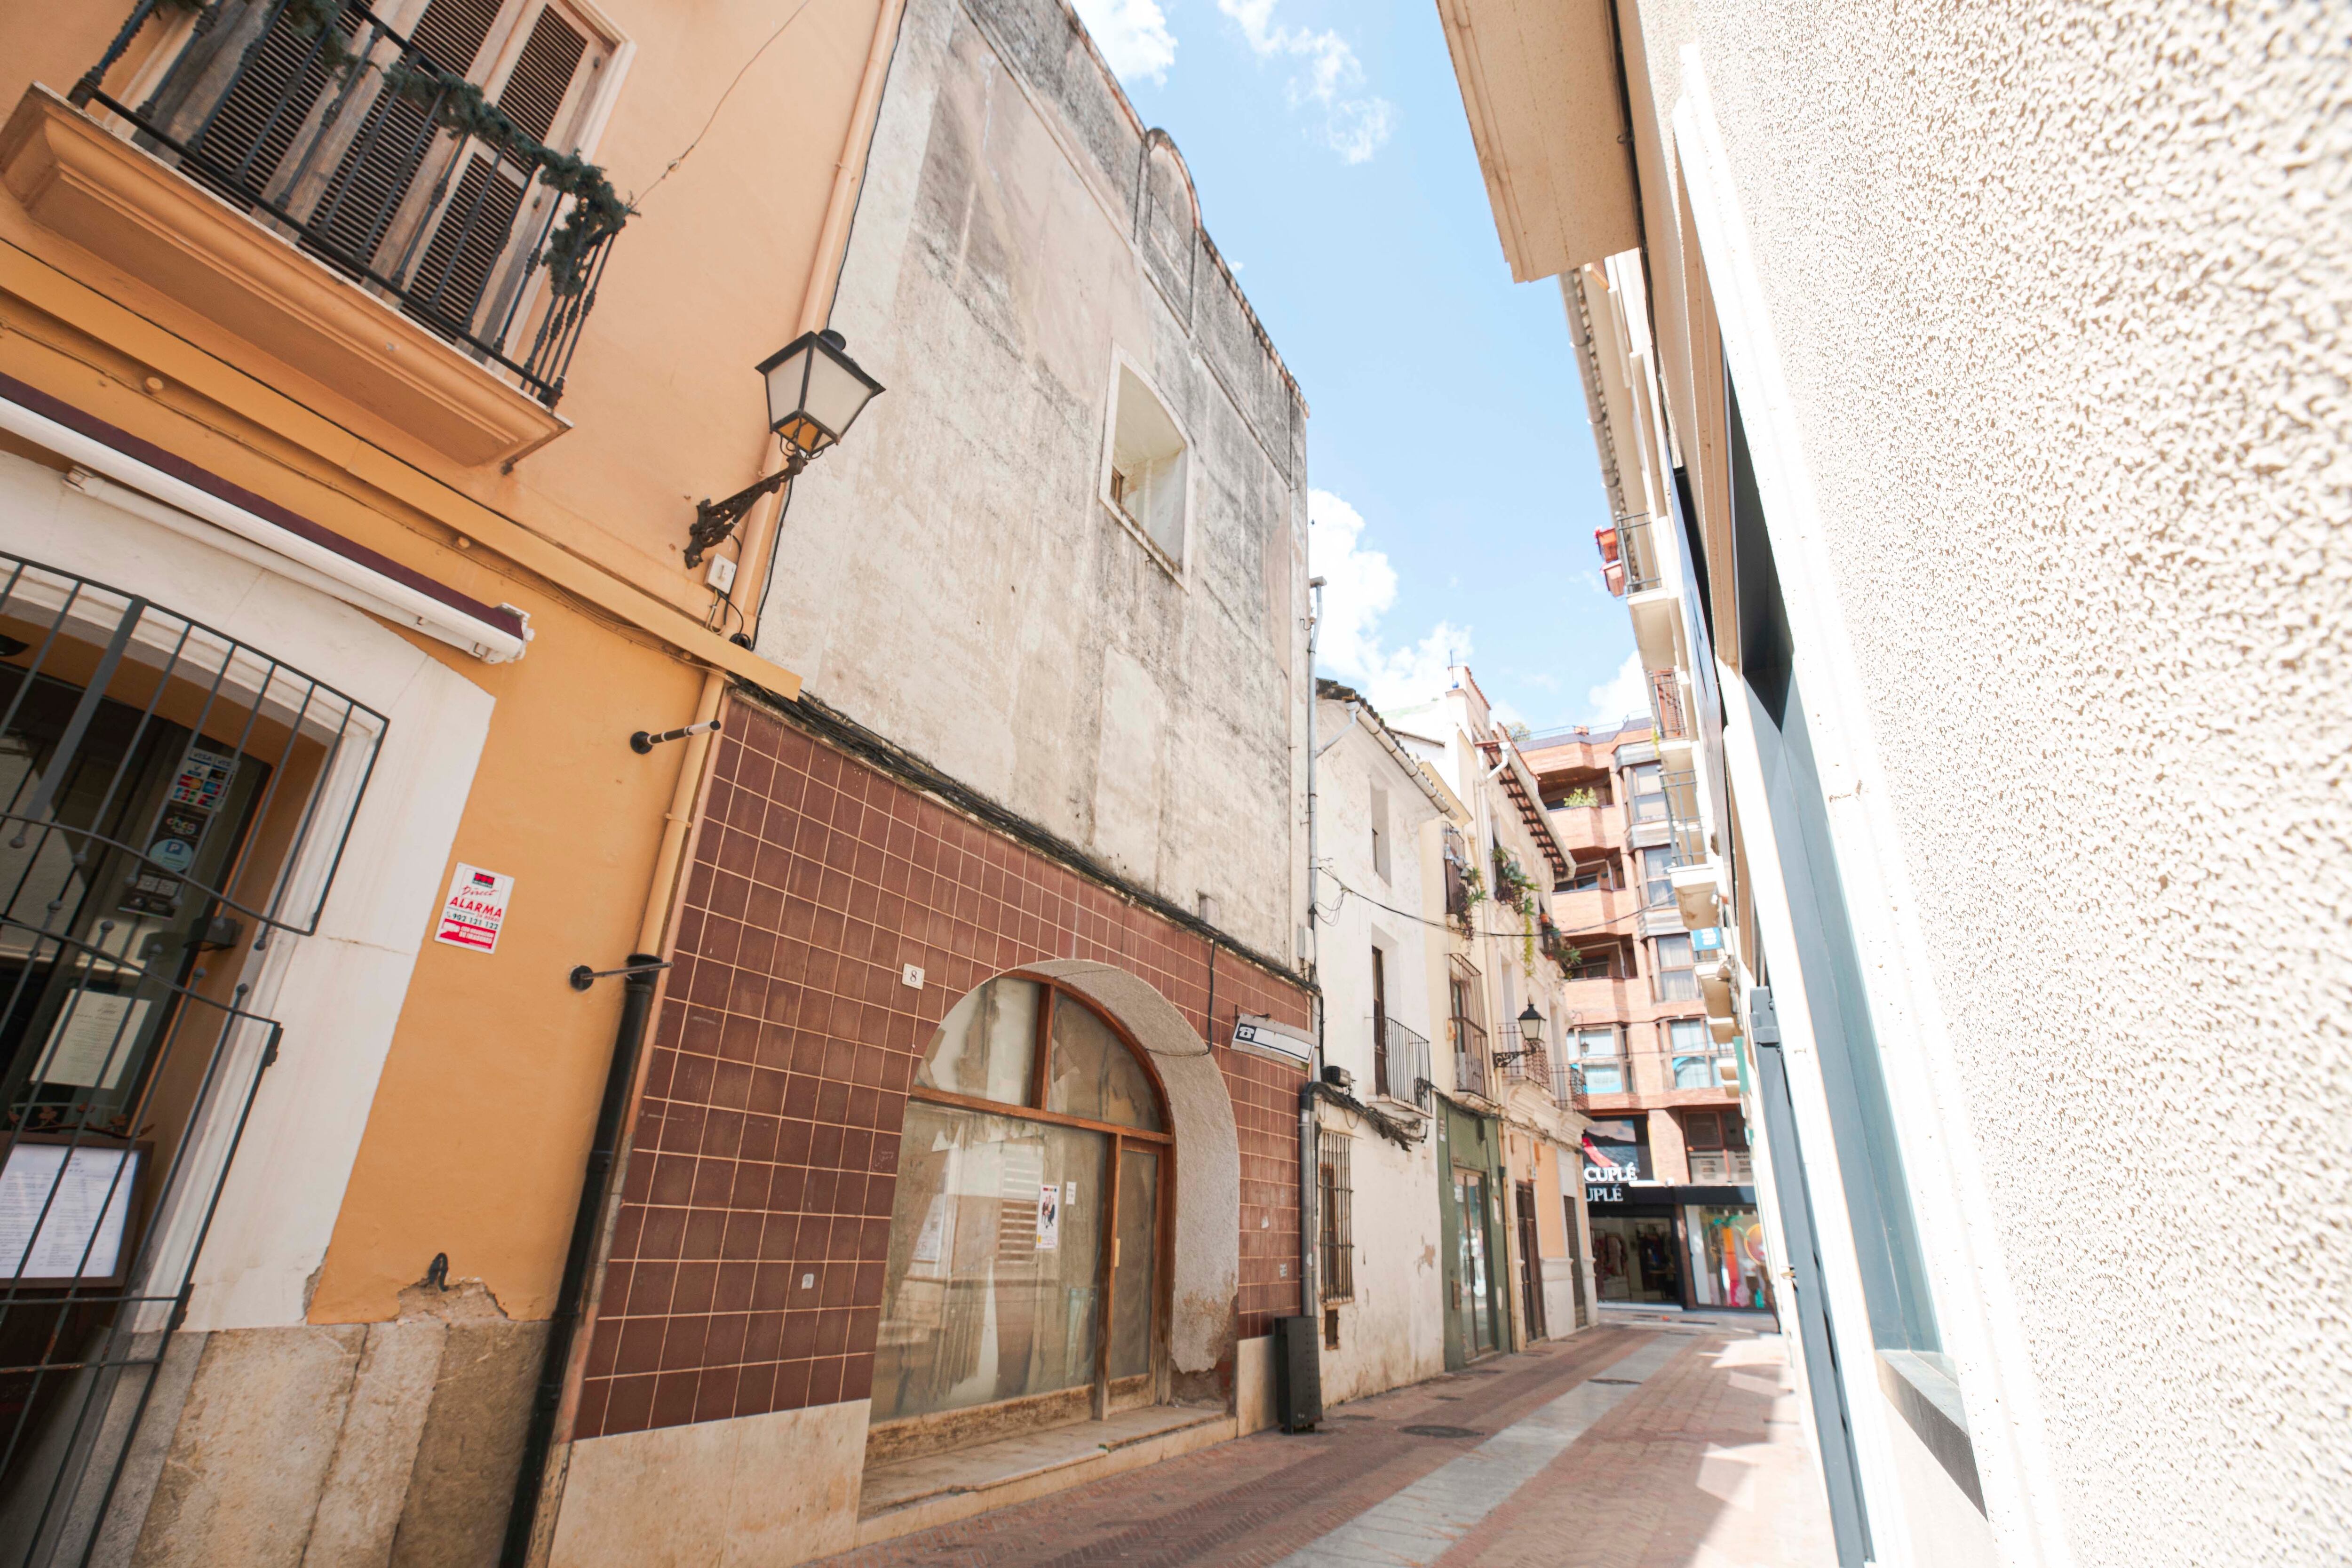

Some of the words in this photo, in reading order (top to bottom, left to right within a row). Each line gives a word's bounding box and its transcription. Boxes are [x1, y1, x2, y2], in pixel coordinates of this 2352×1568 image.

[450, 897, 502, 917] ALARMA
[453, 914, 467, 922] 902
[485, 921, 499, 930] 122
[910, 970, 917, 982] 8
[1583, 1162, 1638, 1182] CUPLÉ
[1586, 1183, 1623, 1202] UPLÉ
